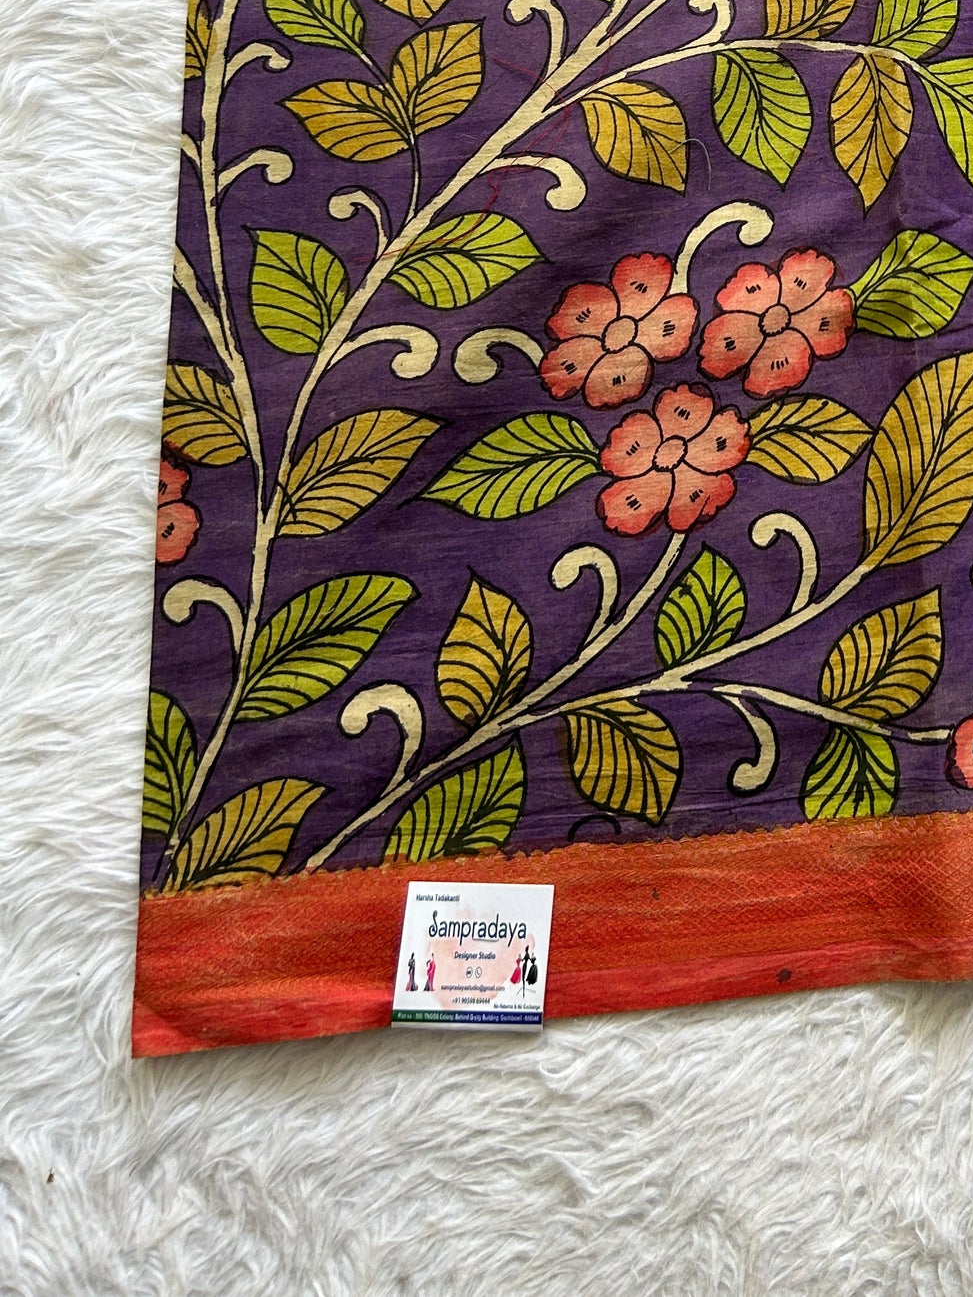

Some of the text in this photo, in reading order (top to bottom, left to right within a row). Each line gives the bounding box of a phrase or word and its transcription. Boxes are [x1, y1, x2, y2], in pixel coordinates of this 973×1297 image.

[416, 893, 434, 902] Harsha
[428, 909, 527, 947] Sampradaya
[454, 951, 496, 961] Designer Studio
